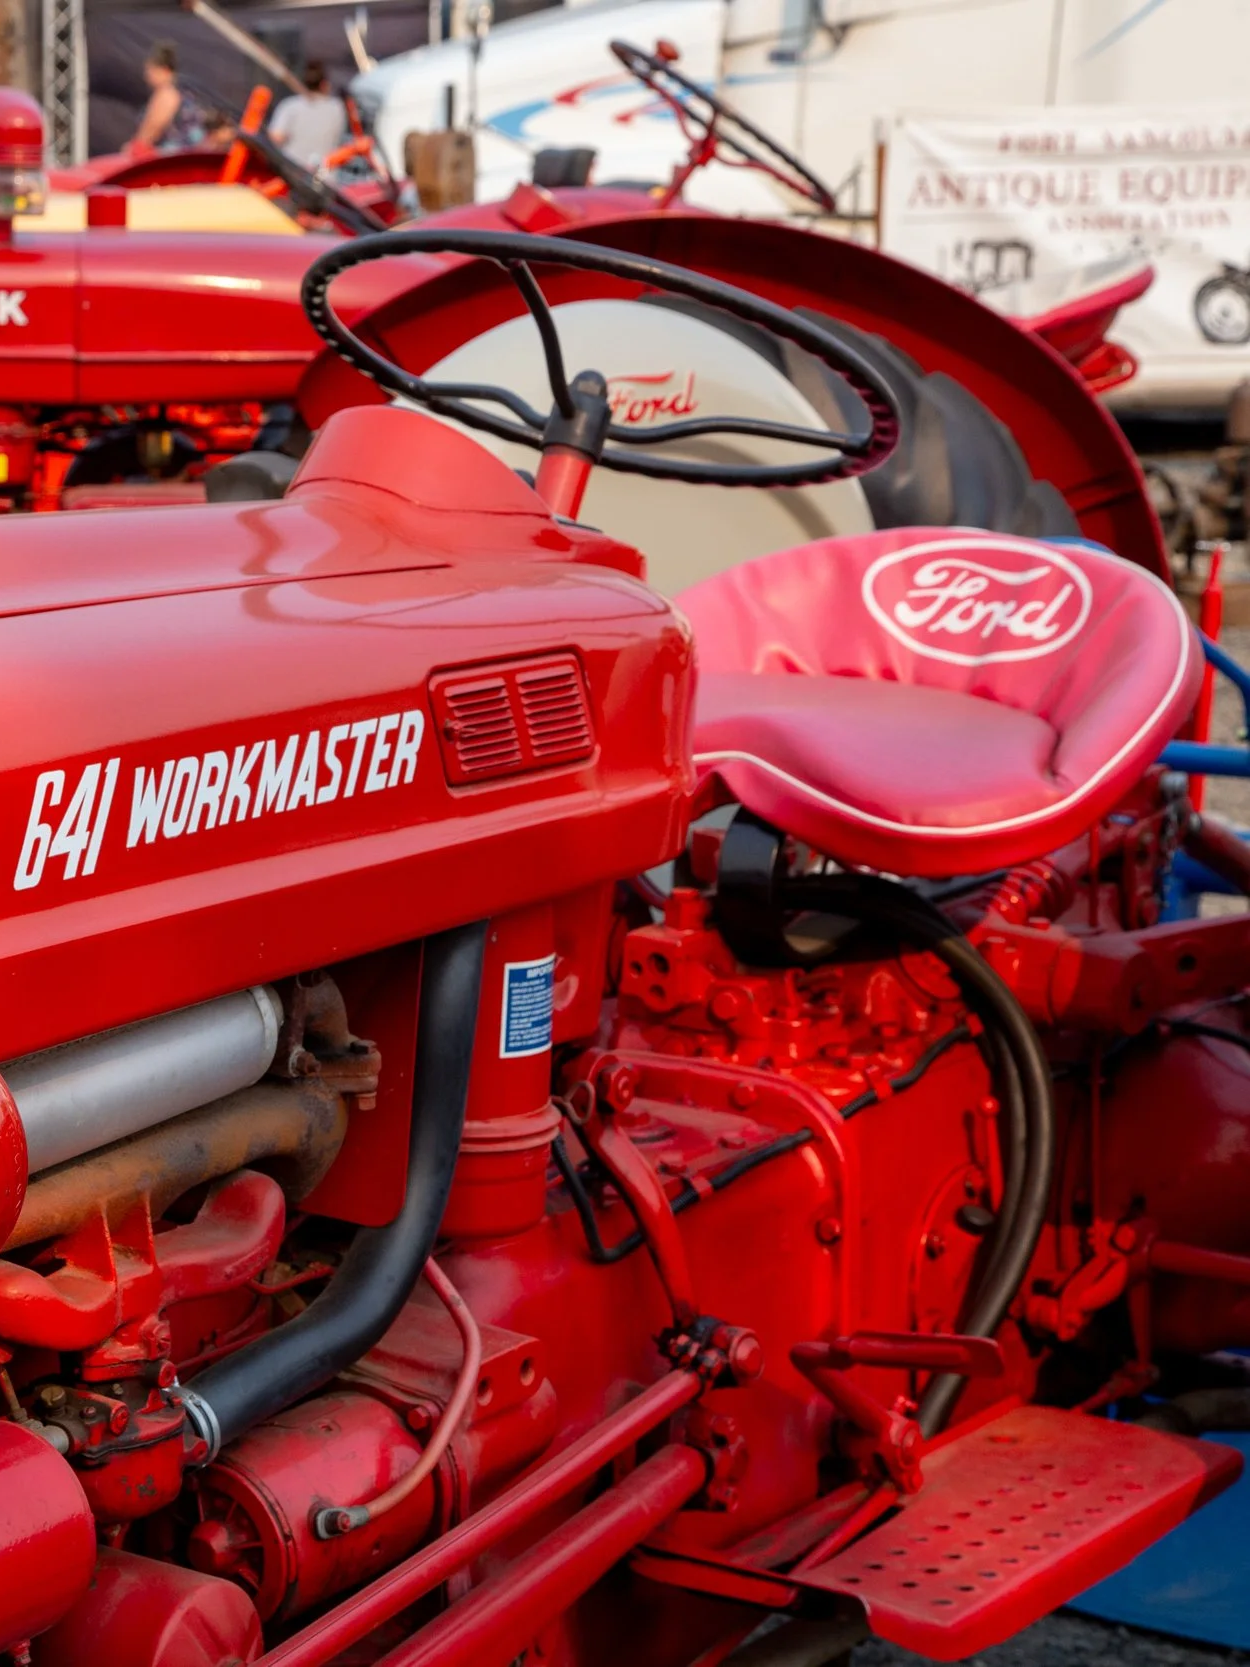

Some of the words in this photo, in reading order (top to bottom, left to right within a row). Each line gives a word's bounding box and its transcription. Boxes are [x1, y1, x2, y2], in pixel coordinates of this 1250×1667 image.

[909, 170, 1100, 208] ANTIQUE
[1118, 163, 1250, 205] EQUIP
[894, 558, 1073, 640] Ford
[13, 758, 121, 890] 641
[126, 709, 424, 848] WORKMASTER
